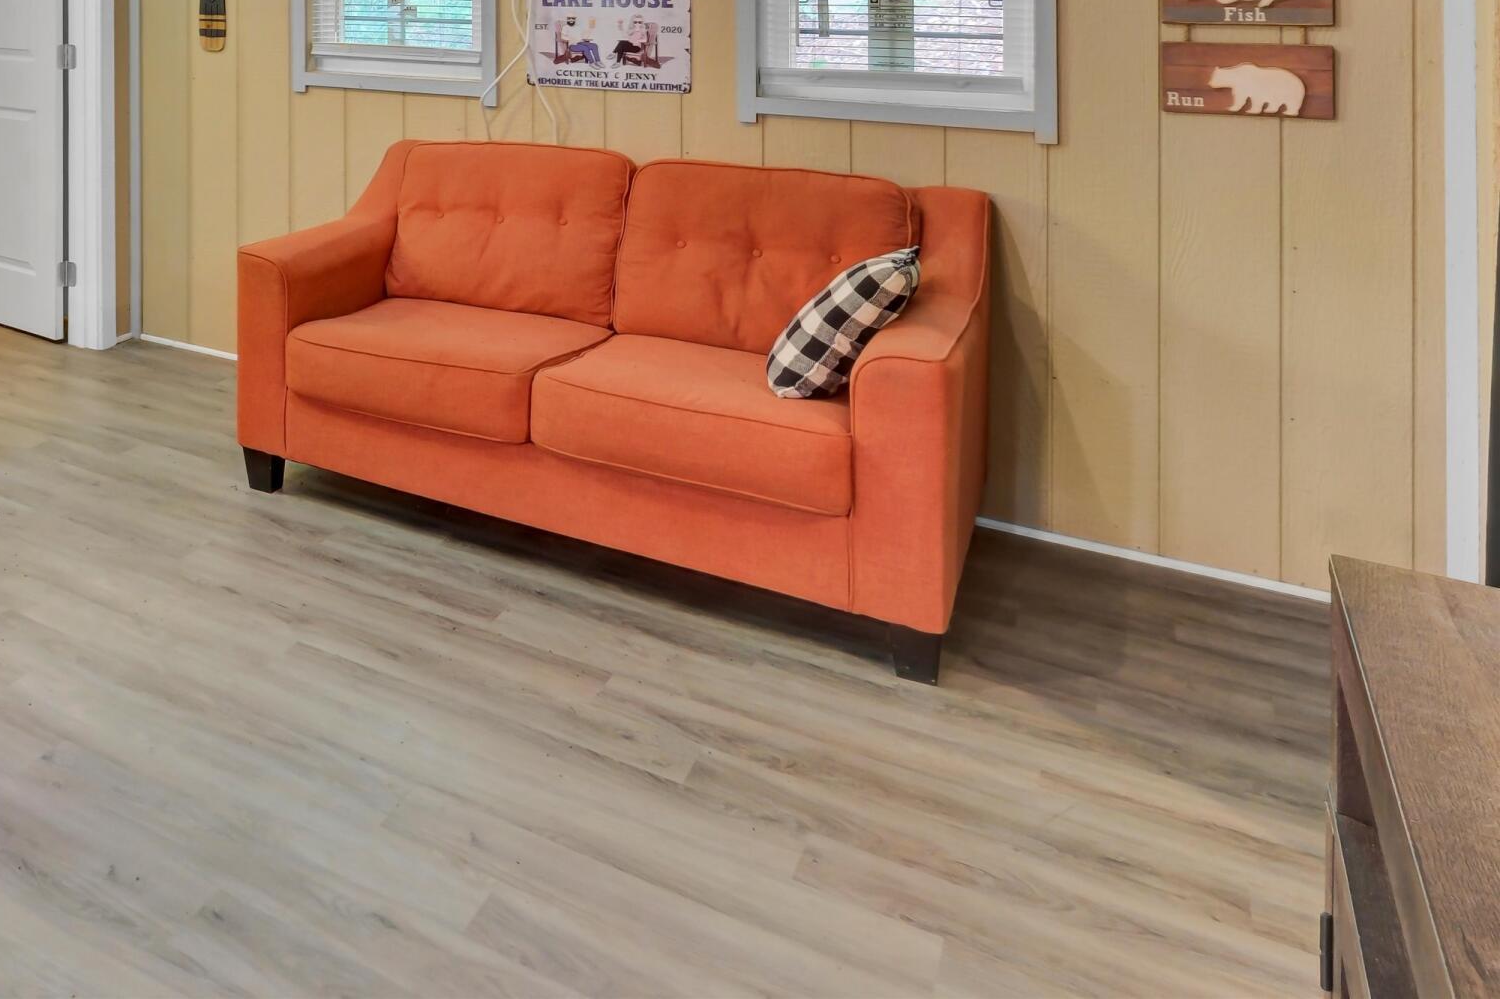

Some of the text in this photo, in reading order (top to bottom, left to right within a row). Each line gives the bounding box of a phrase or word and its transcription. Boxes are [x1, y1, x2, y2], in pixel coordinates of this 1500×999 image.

[1223, 6, 1267, 22] Fish
[660, 25, 683, 34] 2020
[624, 72, 658, 81] JENNY
[573, 79, 583, 87] AT
[585, 80, 599, 88] THE
[601, 81, 619, 89] LAKE
[622, 81, 639, 90] LAST
[641, 82, 648, 90] A
[1166, 91, 1205, 108] Run
